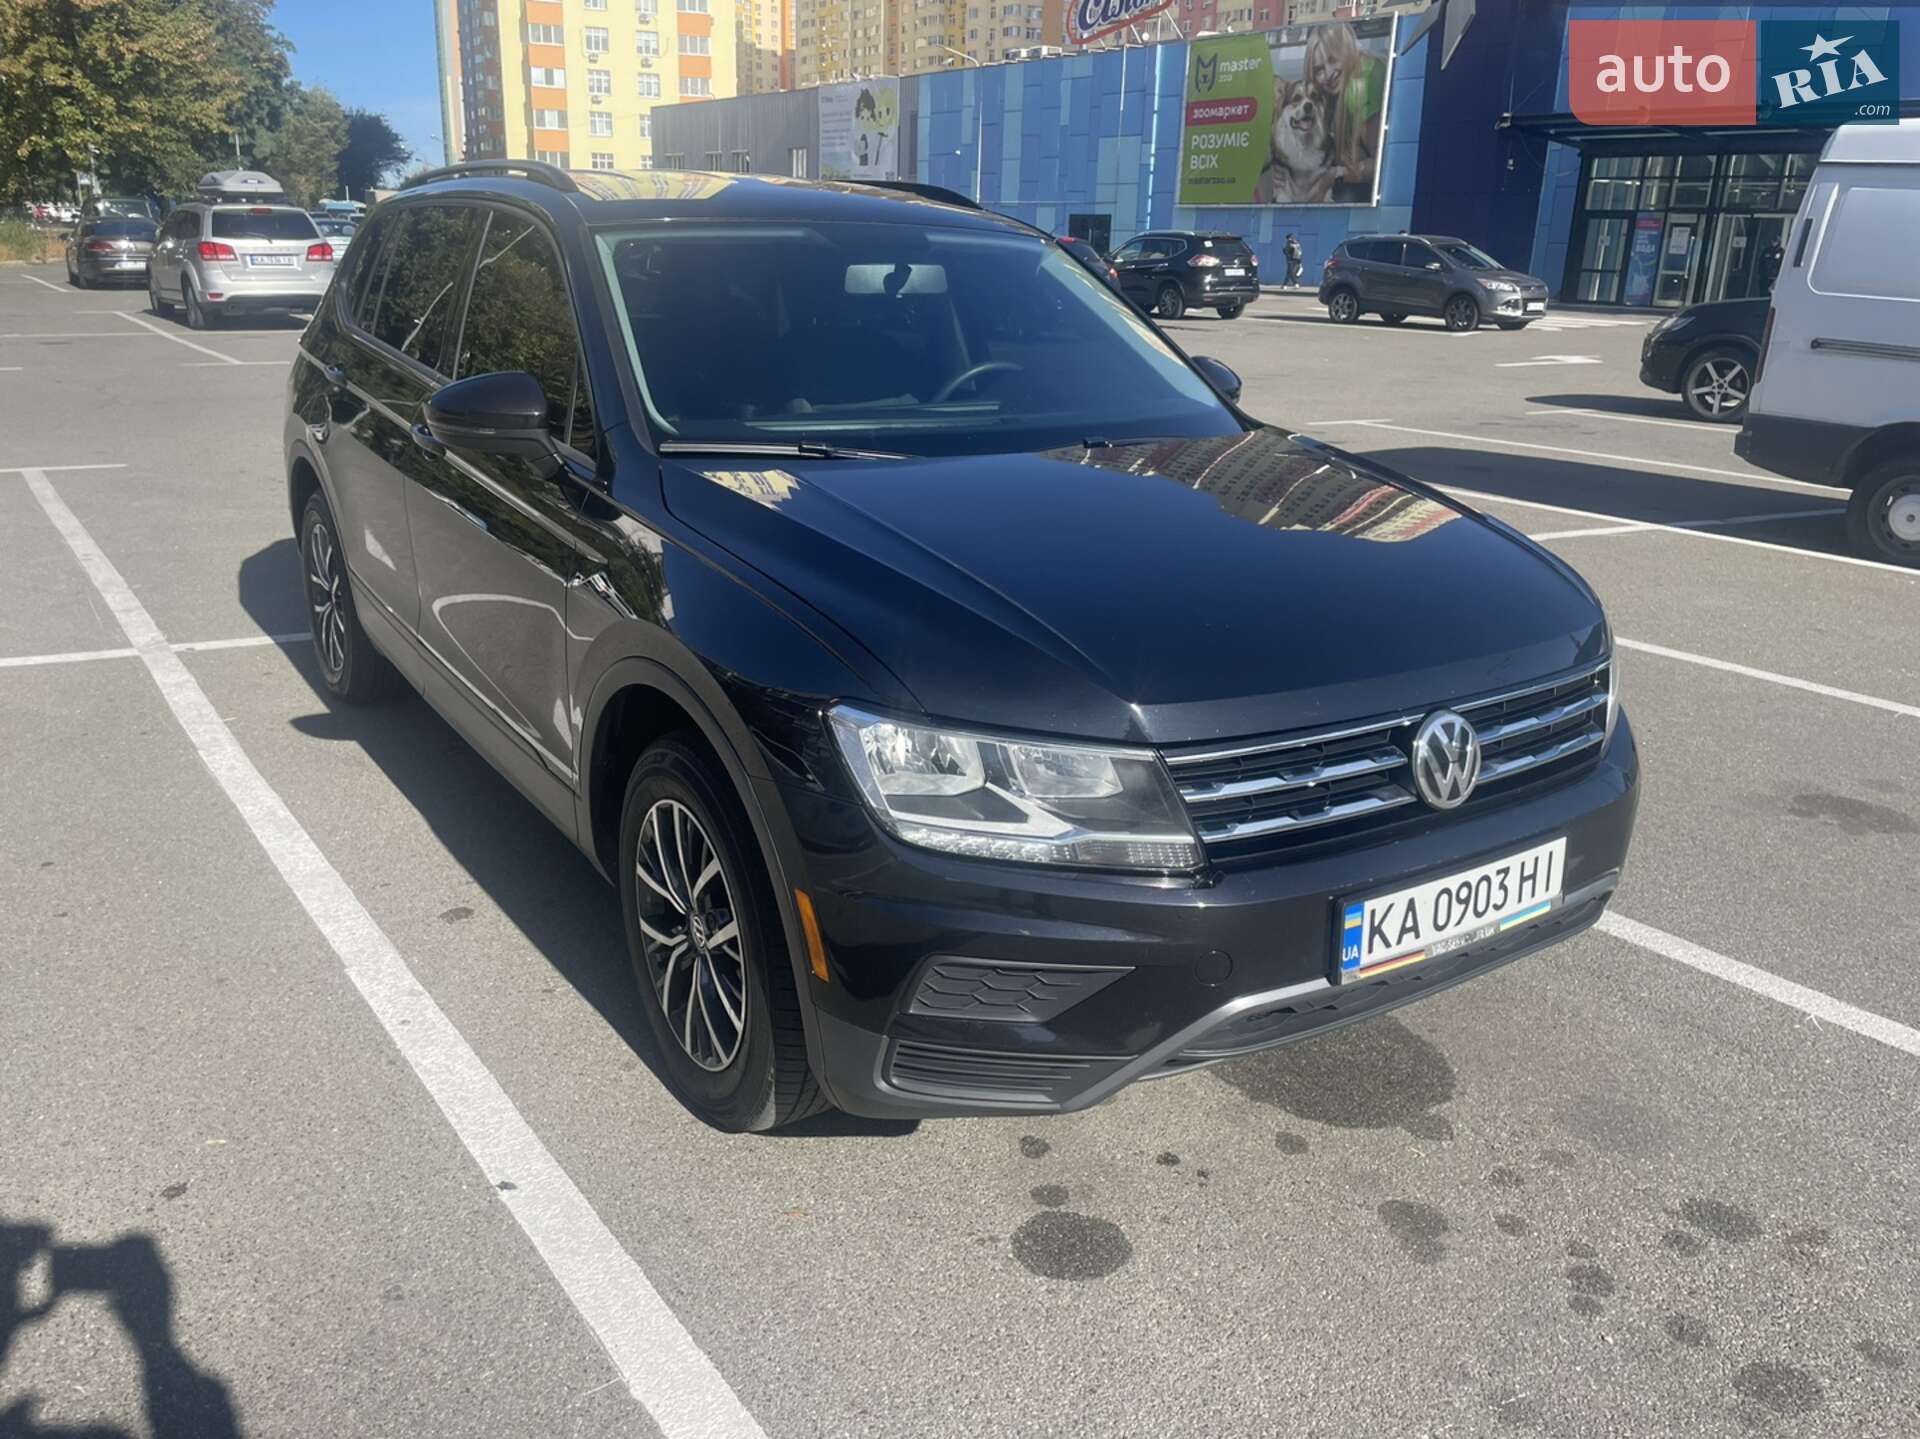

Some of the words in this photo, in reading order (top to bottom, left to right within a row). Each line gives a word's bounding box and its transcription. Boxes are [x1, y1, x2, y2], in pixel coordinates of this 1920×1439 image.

[1220, 57, 1261, 73] master
[1192, 105, 1250, 119] зоомаркет
[1191, 131, 1250, 150] РОЗУМІЄ
[1190, 154, 1219, 170] ВСІХ
[1367, 897, 1421, 954] KA
[1433, 866, 1510, 932] 0903
[1517, 850, 1553, 905] HI
[1342, 944, 1359, 961] UA
